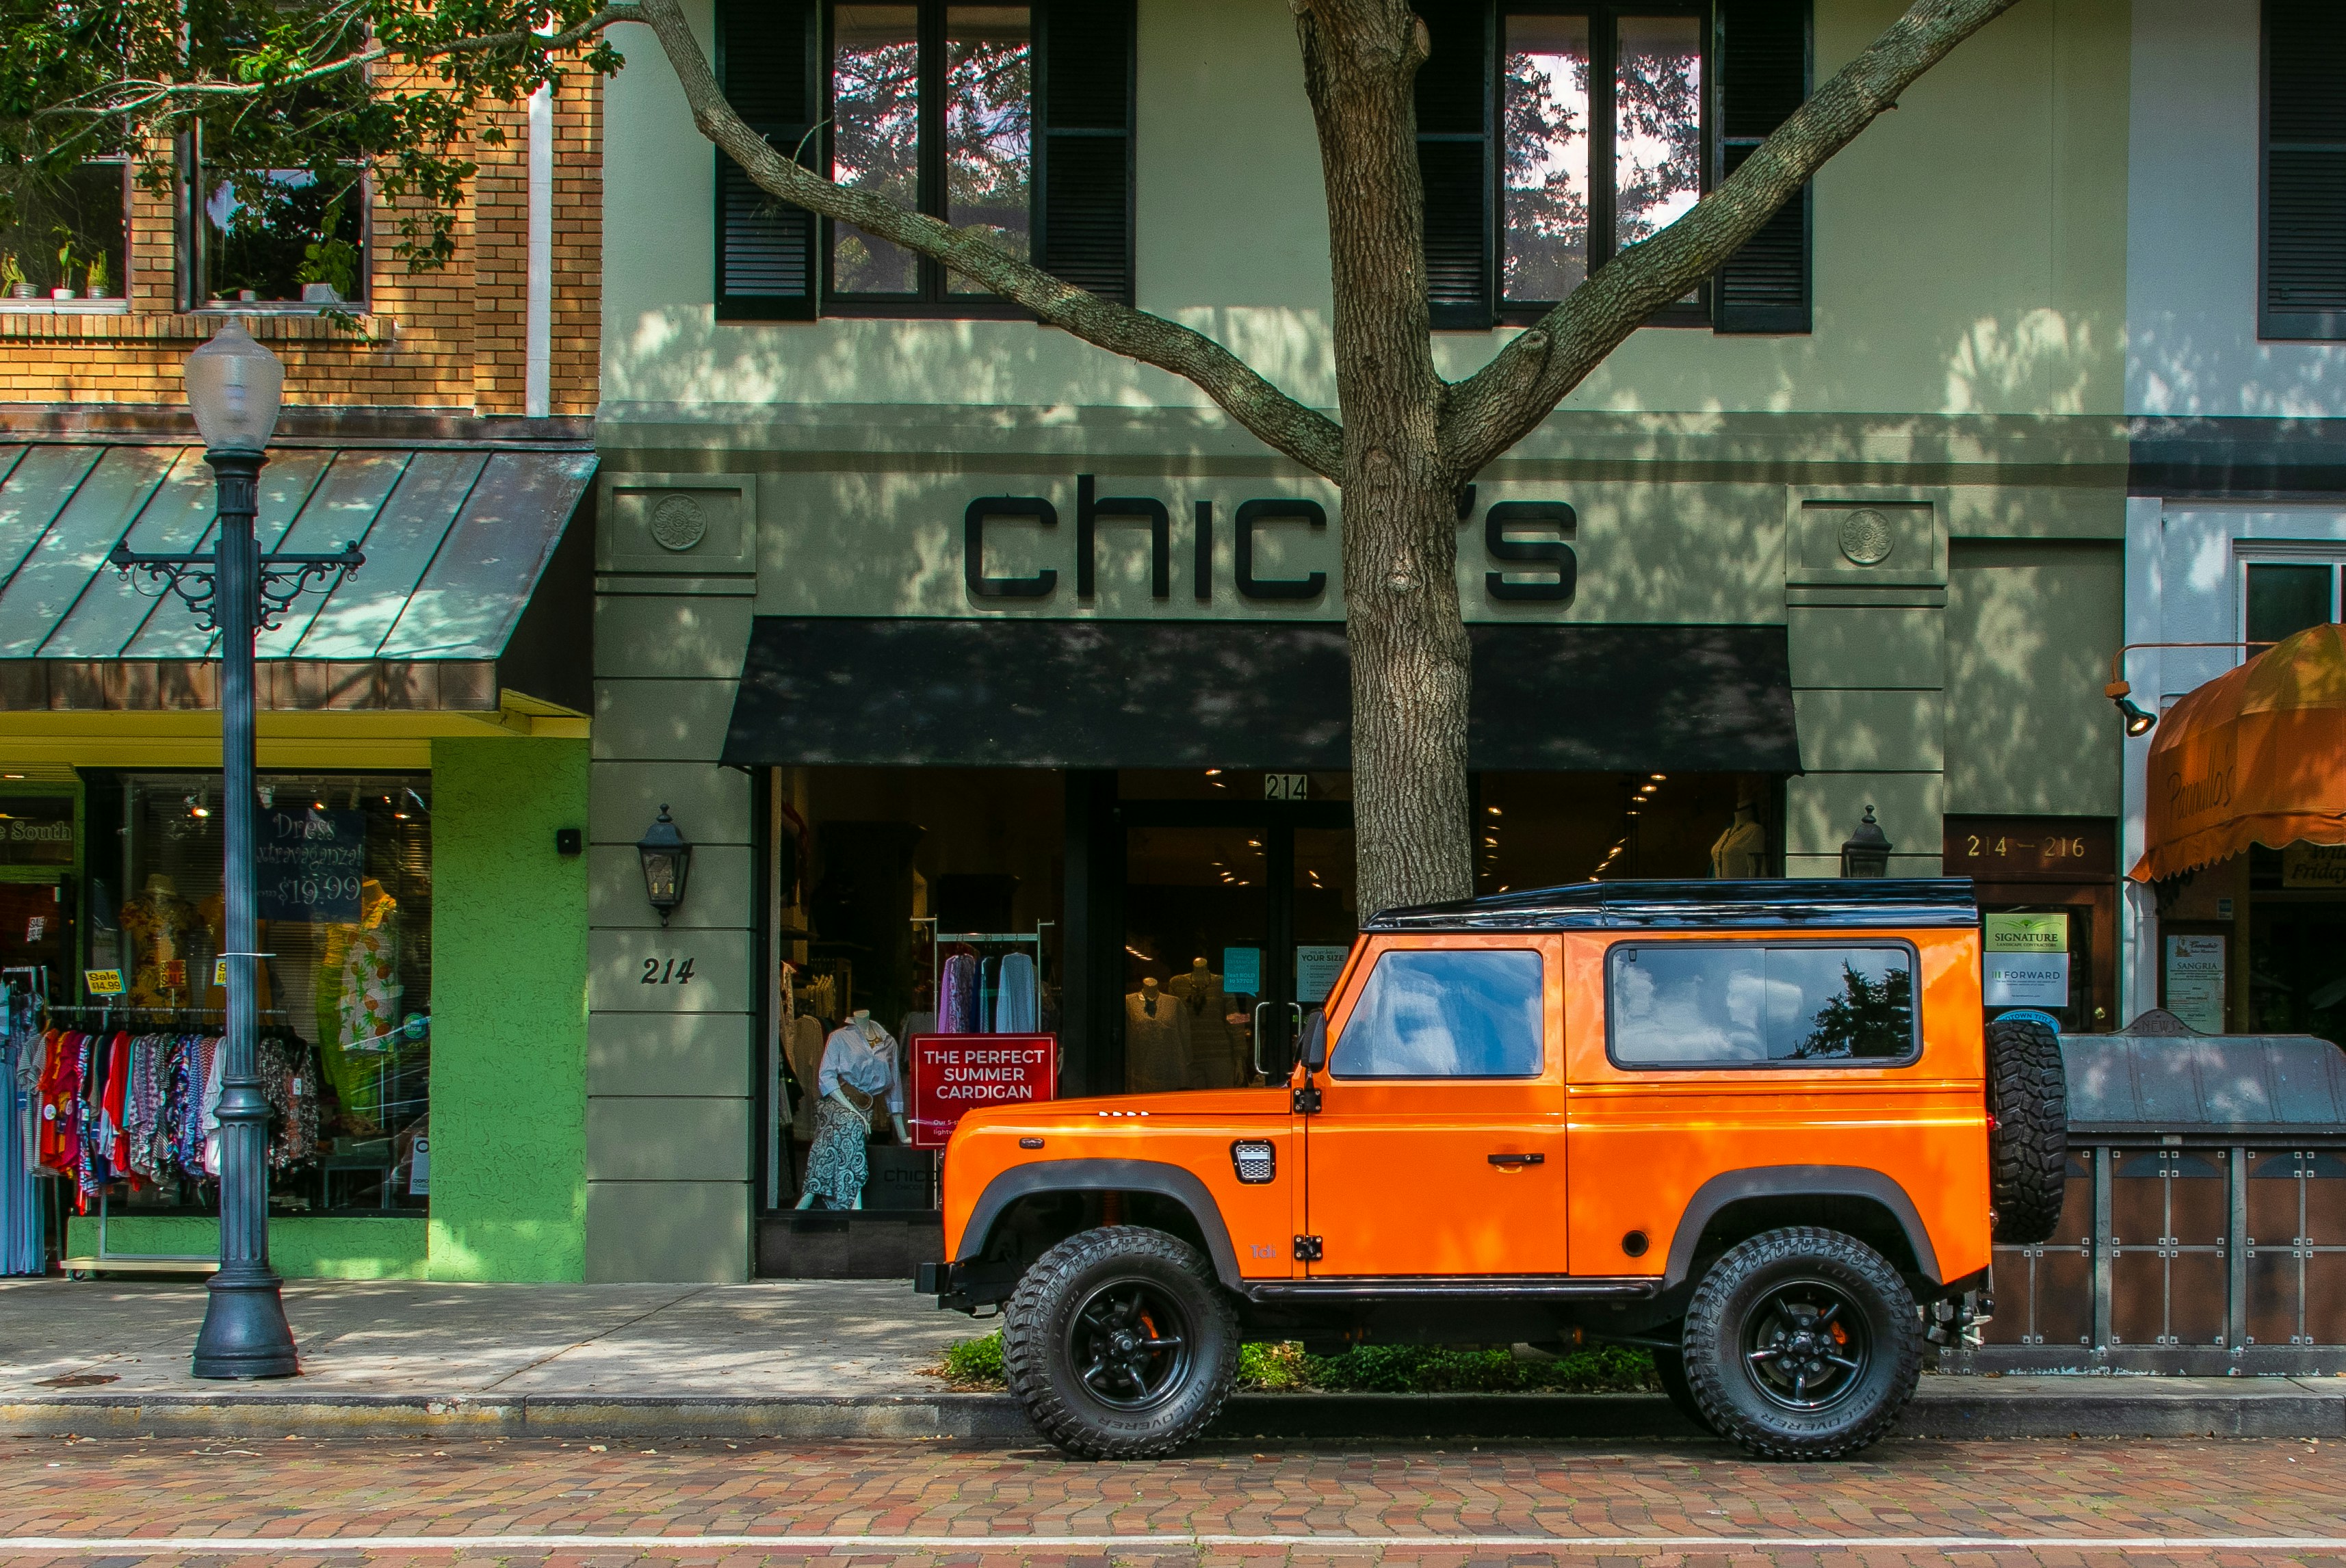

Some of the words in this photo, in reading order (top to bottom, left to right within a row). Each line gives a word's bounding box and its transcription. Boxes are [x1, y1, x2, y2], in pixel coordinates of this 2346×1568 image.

[964, 474, 1576, 600] chic's
[1266, 774, 1306, 799] 214
[11, 820, 73, 841] South
[272, 813, 335, 840] Dress
[2045, 836, 2085, 857] 216
[257, 843, 362, 871] xtravaganza!
[278, 876, 361, 906] $19.99
[1994, 932, 2058, 942] SIGNATURE
[641, 957, 695, 984] 214
[2176, 962, 2217, 970] SANGRIA
[89, 972, 118, 981] Sale
[2005, 971, 2061, 980] FORWARD
[2035, 1014, 2054, 1025] TITLE
[2141, 1020, 2176, 1033] NEWS
[924, 1051, 959, 1064] THE
[965, 1050, 1045, 1064] PERFECT
[943, 1067, 1025, 1082] SUMMER
[936, 1085, 1032, 1099] CARDIGAN
[1248, 1244, 1277, 1259] Tdi
[1097, 1379, 1205, 1430] DISCOVERER
[1760, 1388, 1877, 1432] DISCOVERER
